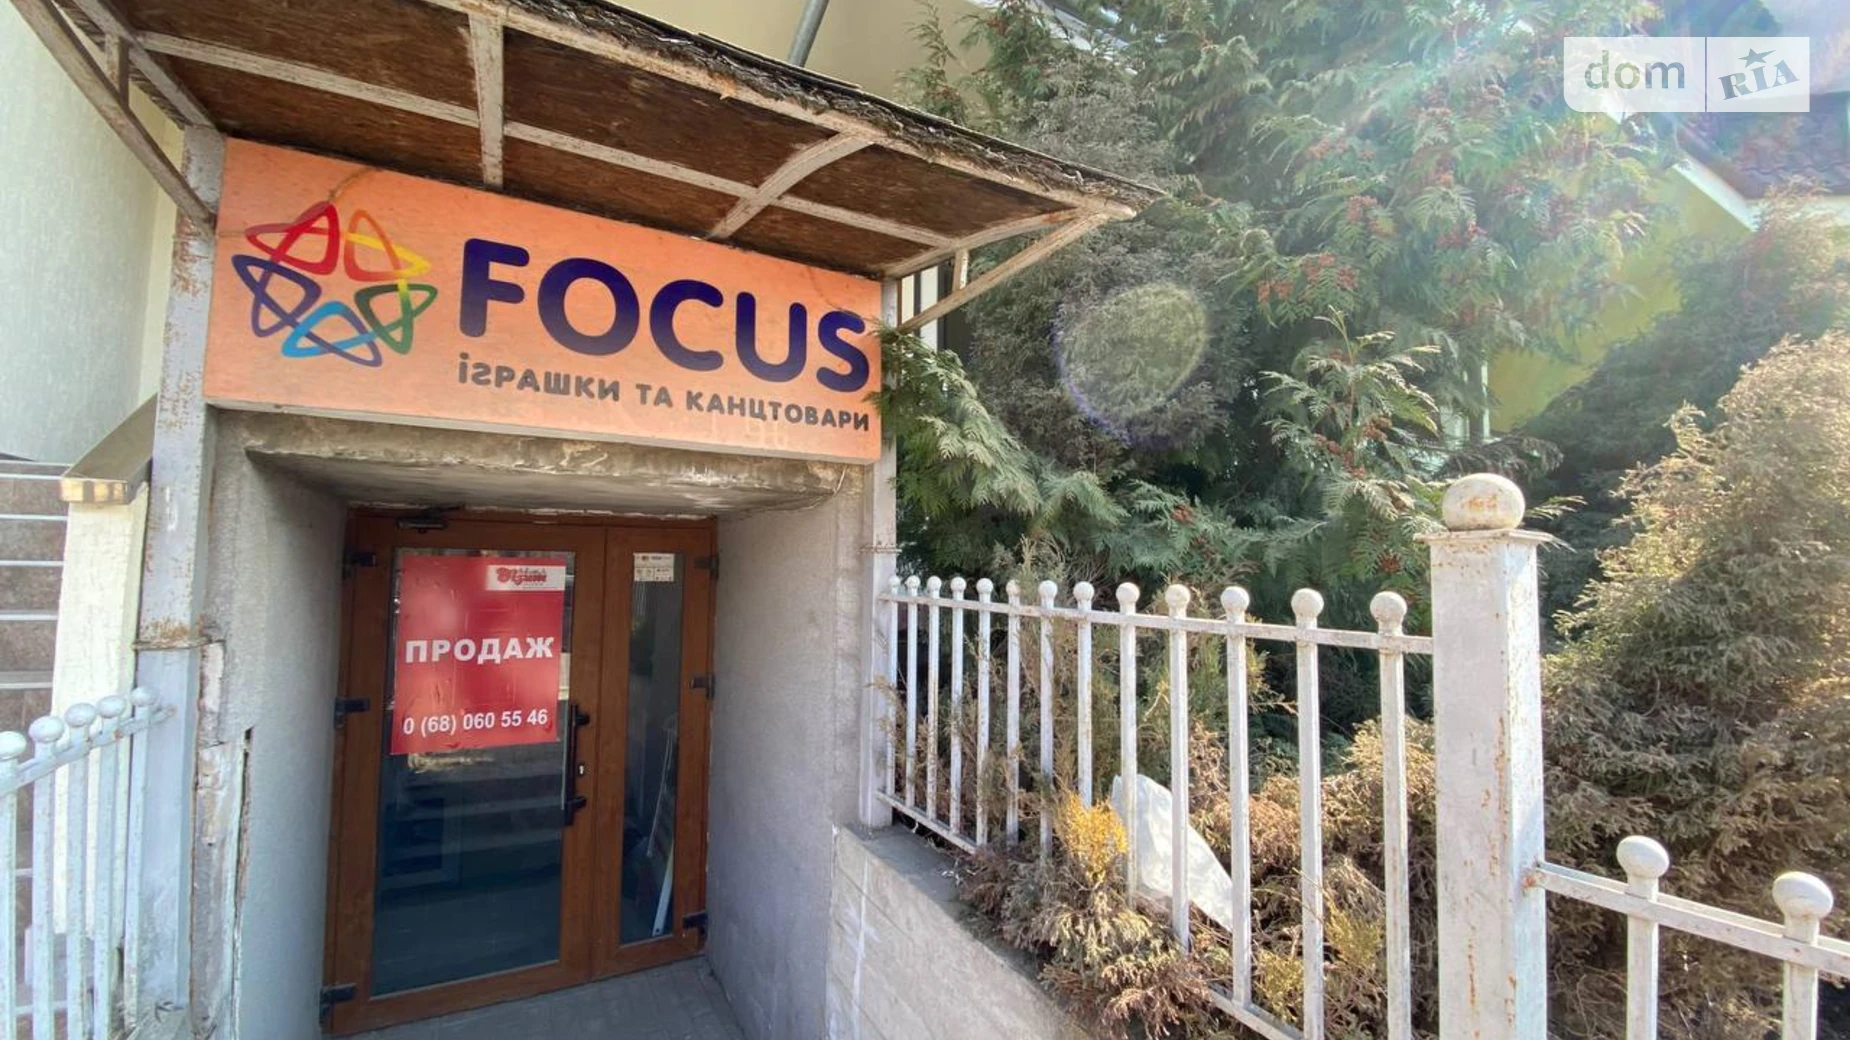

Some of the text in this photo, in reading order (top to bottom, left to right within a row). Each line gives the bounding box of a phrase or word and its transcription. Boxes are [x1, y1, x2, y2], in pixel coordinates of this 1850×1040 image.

[459, 238, 870, 392] FOCUS
[635, 383, 673, 408] ТА
[686, 390, 870, 431] КАНЦТОВАРИ
[405, 637, 554, 664] ПРОДАЖ
[403, 708, 548, 738] 0 (68) 060 55 46
